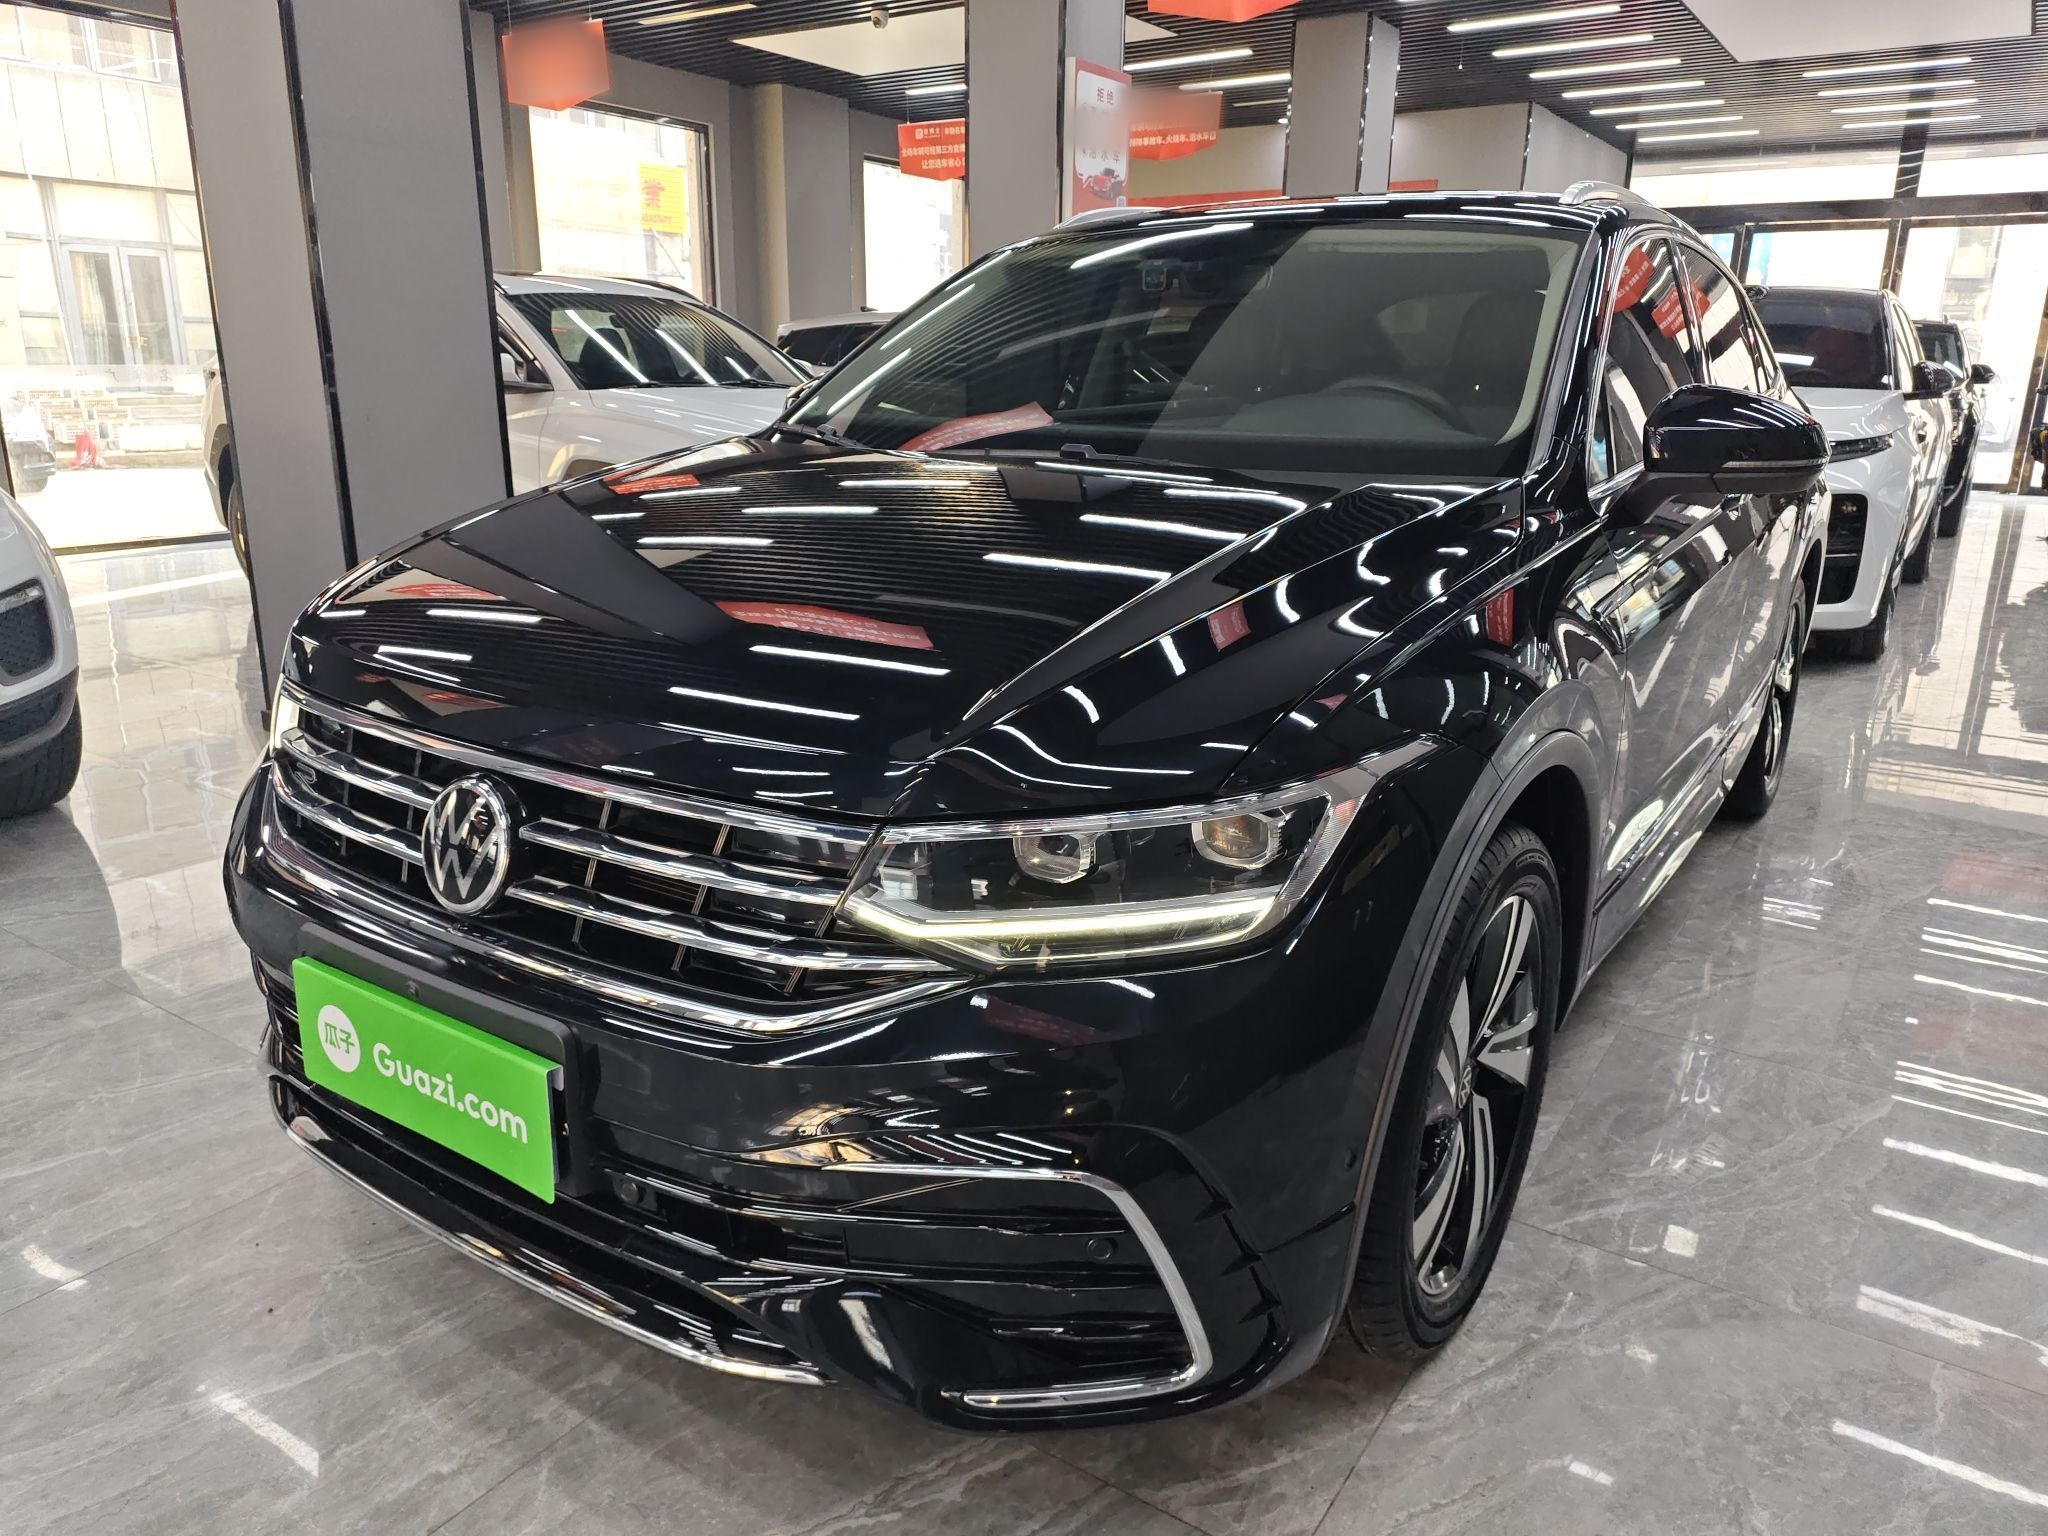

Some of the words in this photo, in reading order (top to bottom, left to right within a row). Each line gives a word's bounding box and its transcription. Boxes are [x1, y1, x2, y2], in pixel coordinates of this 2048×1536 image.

[1096, 87, 1114, 105] 拒绝
[324, 1022, 356, 1055] 瓜子
[373, 1042, 528, 1144] Guazi.com
